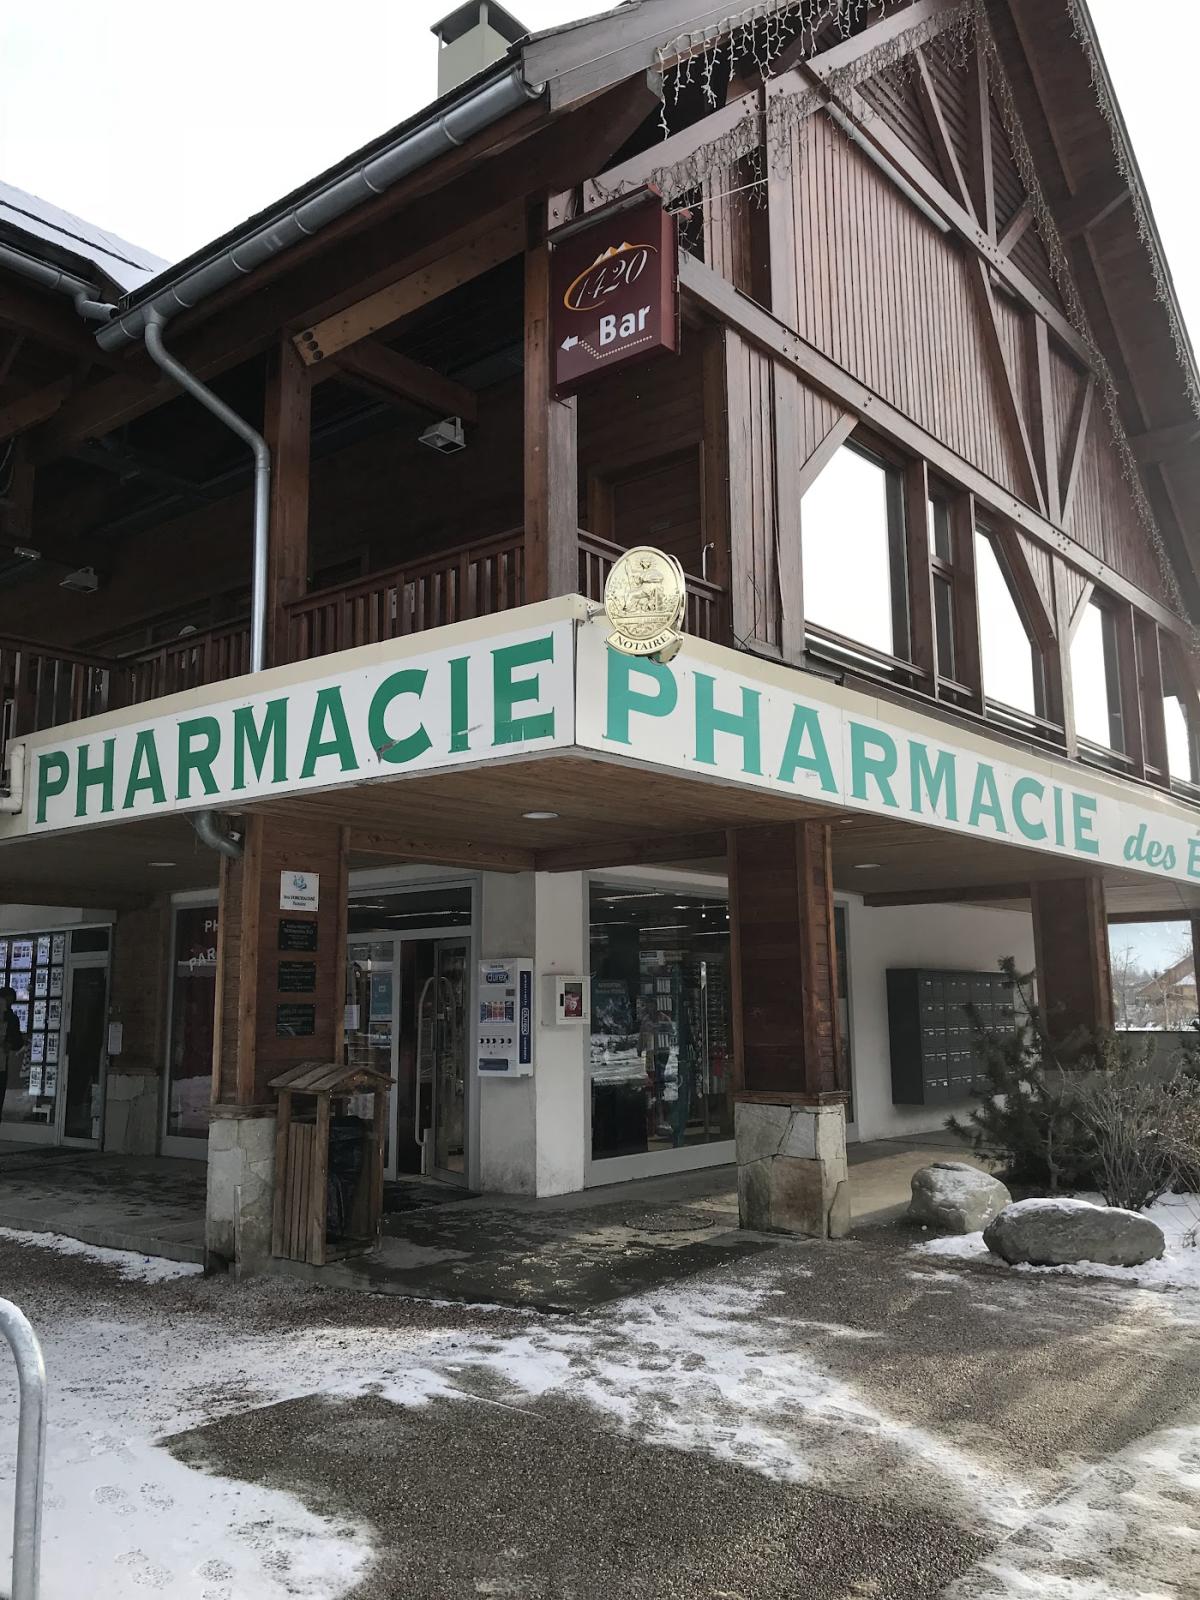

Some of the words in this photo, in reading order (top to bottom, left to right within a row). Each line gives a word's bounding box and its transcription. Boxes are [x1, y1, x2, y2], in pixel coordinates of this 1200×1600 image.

[575, 249, 648, 308] 1420
[599, 305, 651, 347] Bar
[615, 633, 671, 651] NOTAIRE
[35, 630, 556, 825] PHARMACIE
[602, 648, 1100, 856] PHARMACIE
[1123, 823, 1177, 871] des
[487, 973, 508, 983] durex
